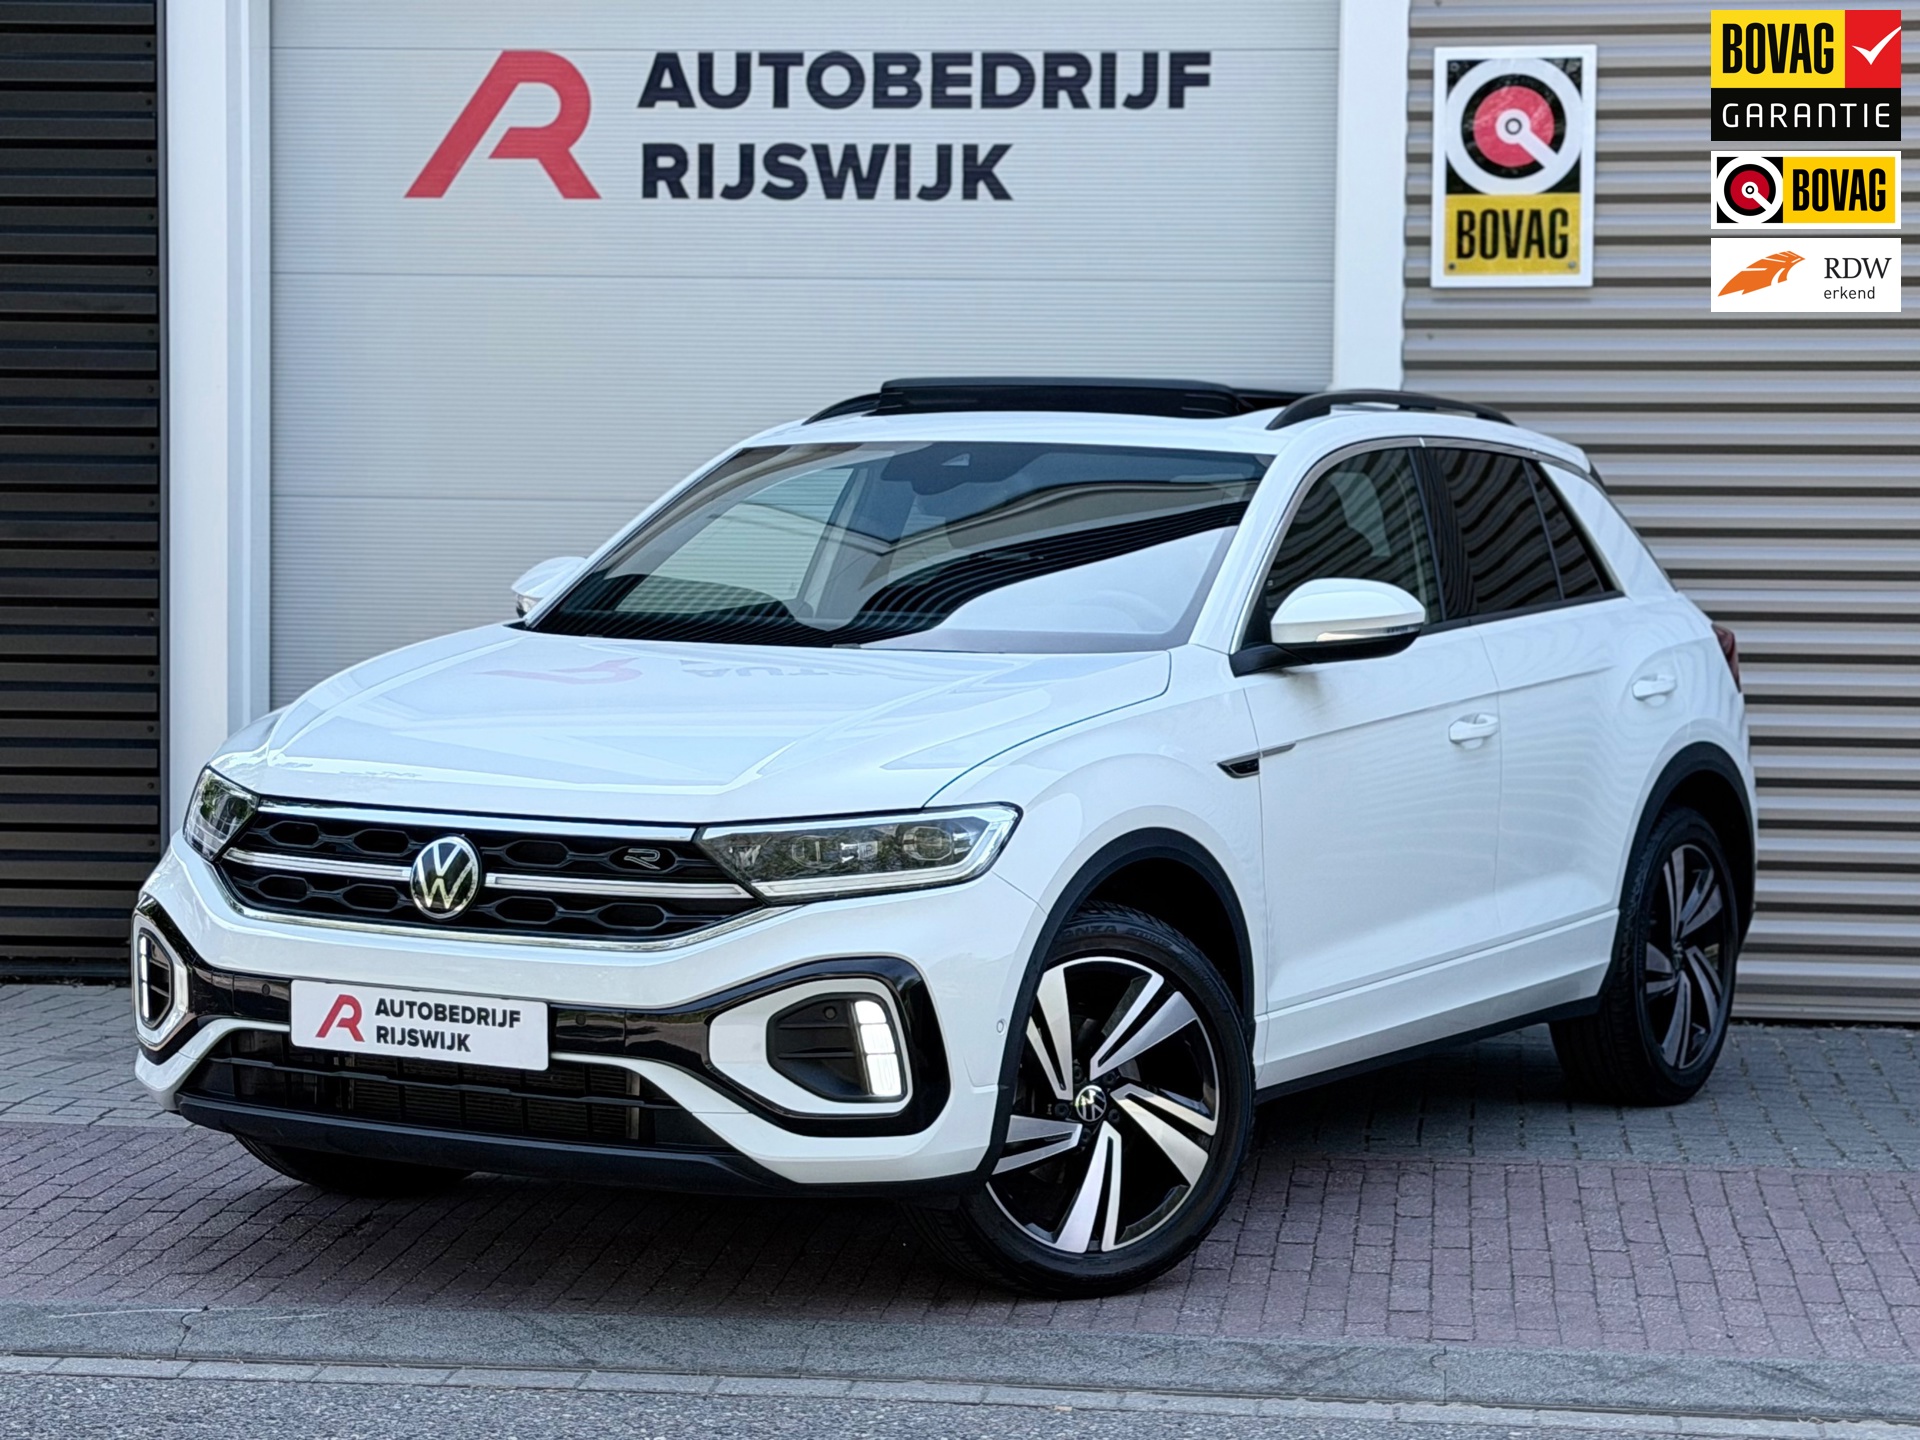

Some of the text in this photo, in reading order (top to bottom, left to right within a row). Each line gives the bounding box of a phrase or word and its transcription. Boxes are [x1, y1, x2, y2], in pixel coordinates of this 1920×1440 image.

[637, 51, 1212, 109] AUTOBEDRIJF
[641, 143, 1013, 201] RIJSWIJK
[1456, 208, 1569, 260] BOVAG
[374, 998, 521, 1028] AUTOBEDRIJF
[375, 1025, 471, 1053] RIJSWIJK
